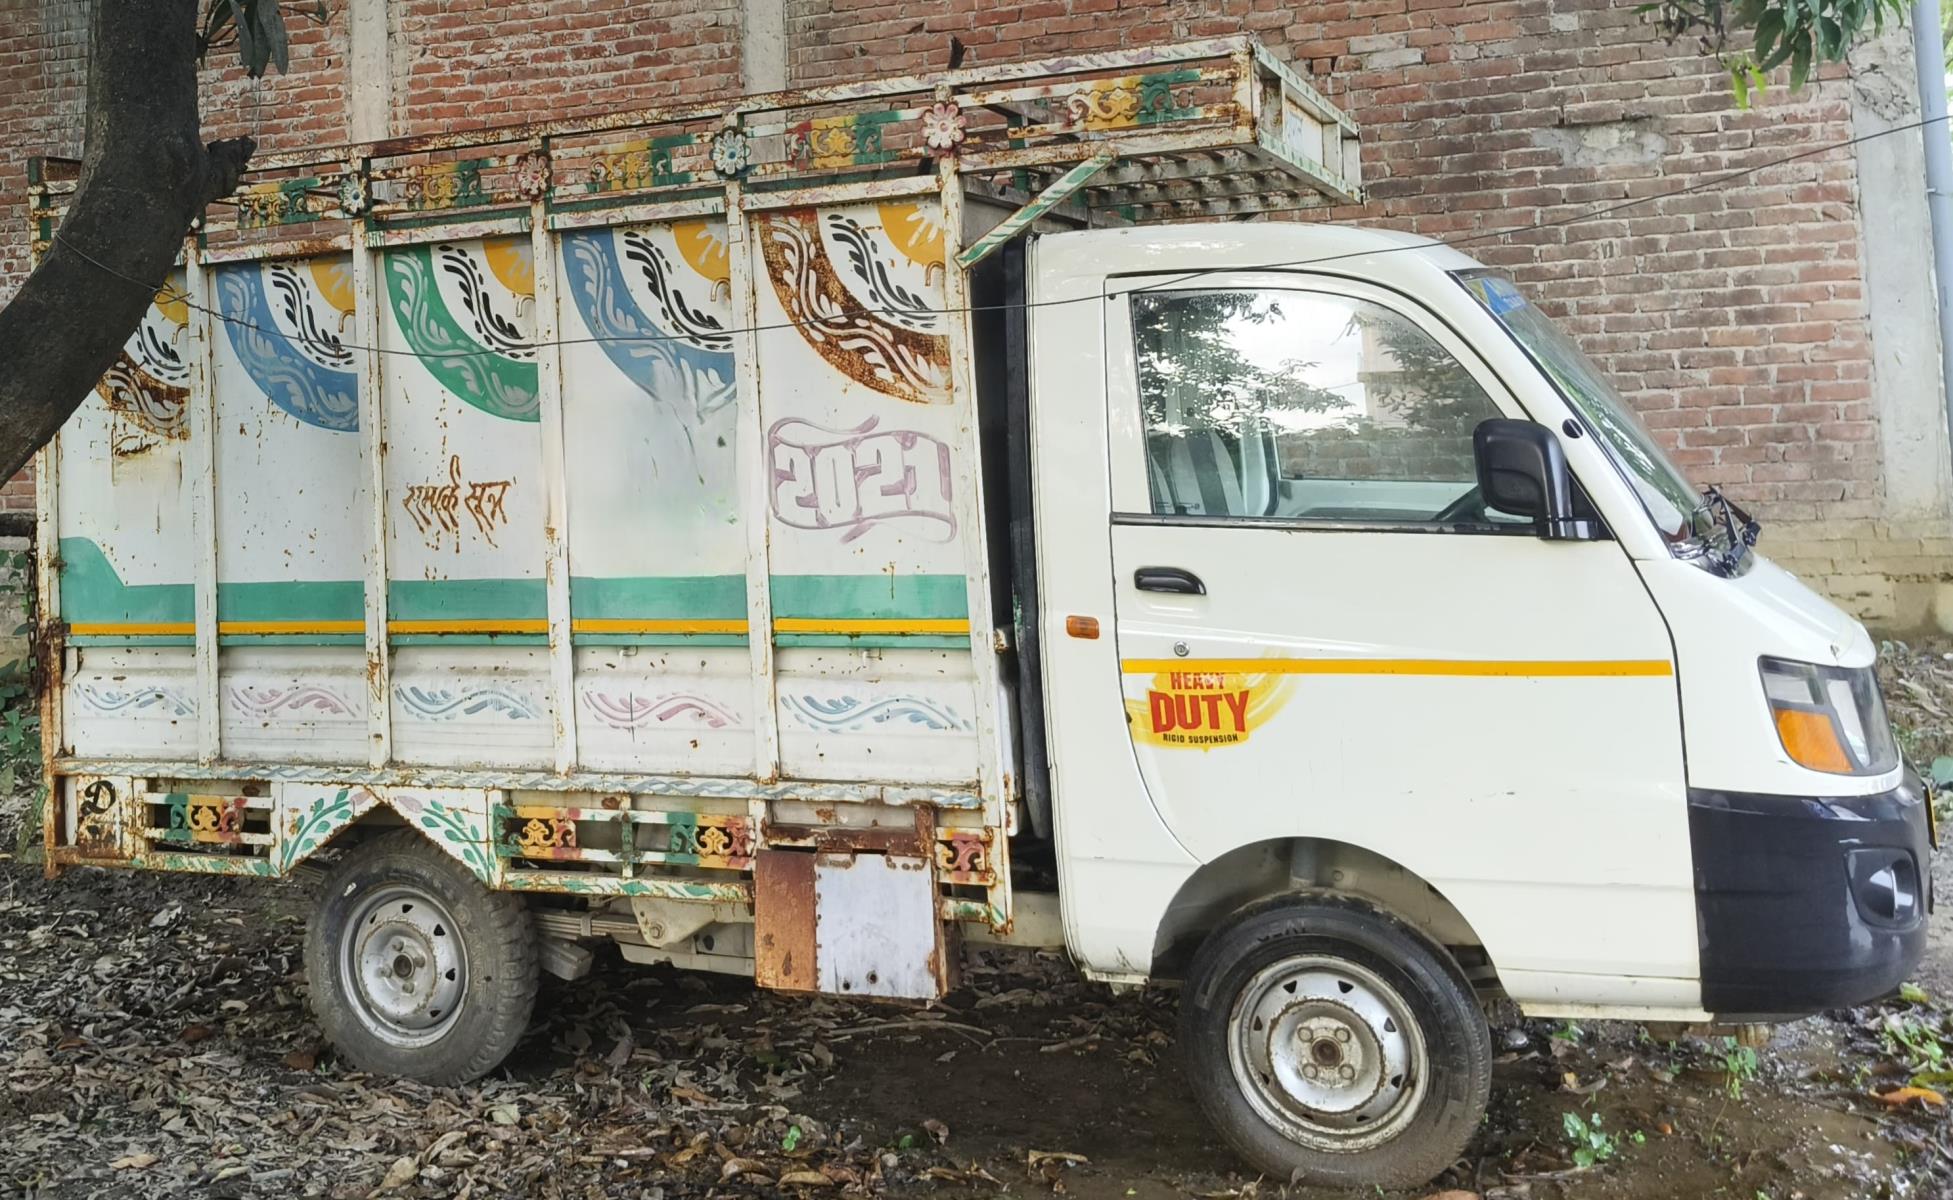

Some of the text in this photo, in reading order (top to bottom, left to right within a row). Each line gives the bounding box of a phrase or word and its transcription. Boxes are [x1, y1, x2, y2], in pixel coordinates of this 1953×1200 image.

[773, 434, 952, 526] 2021
[1170, 671, 1225, 690] HEAVY
[1149, 690, 1249, 733] DUTY
[1163, 733, 1238, 744] RIGID SUSPENSION
